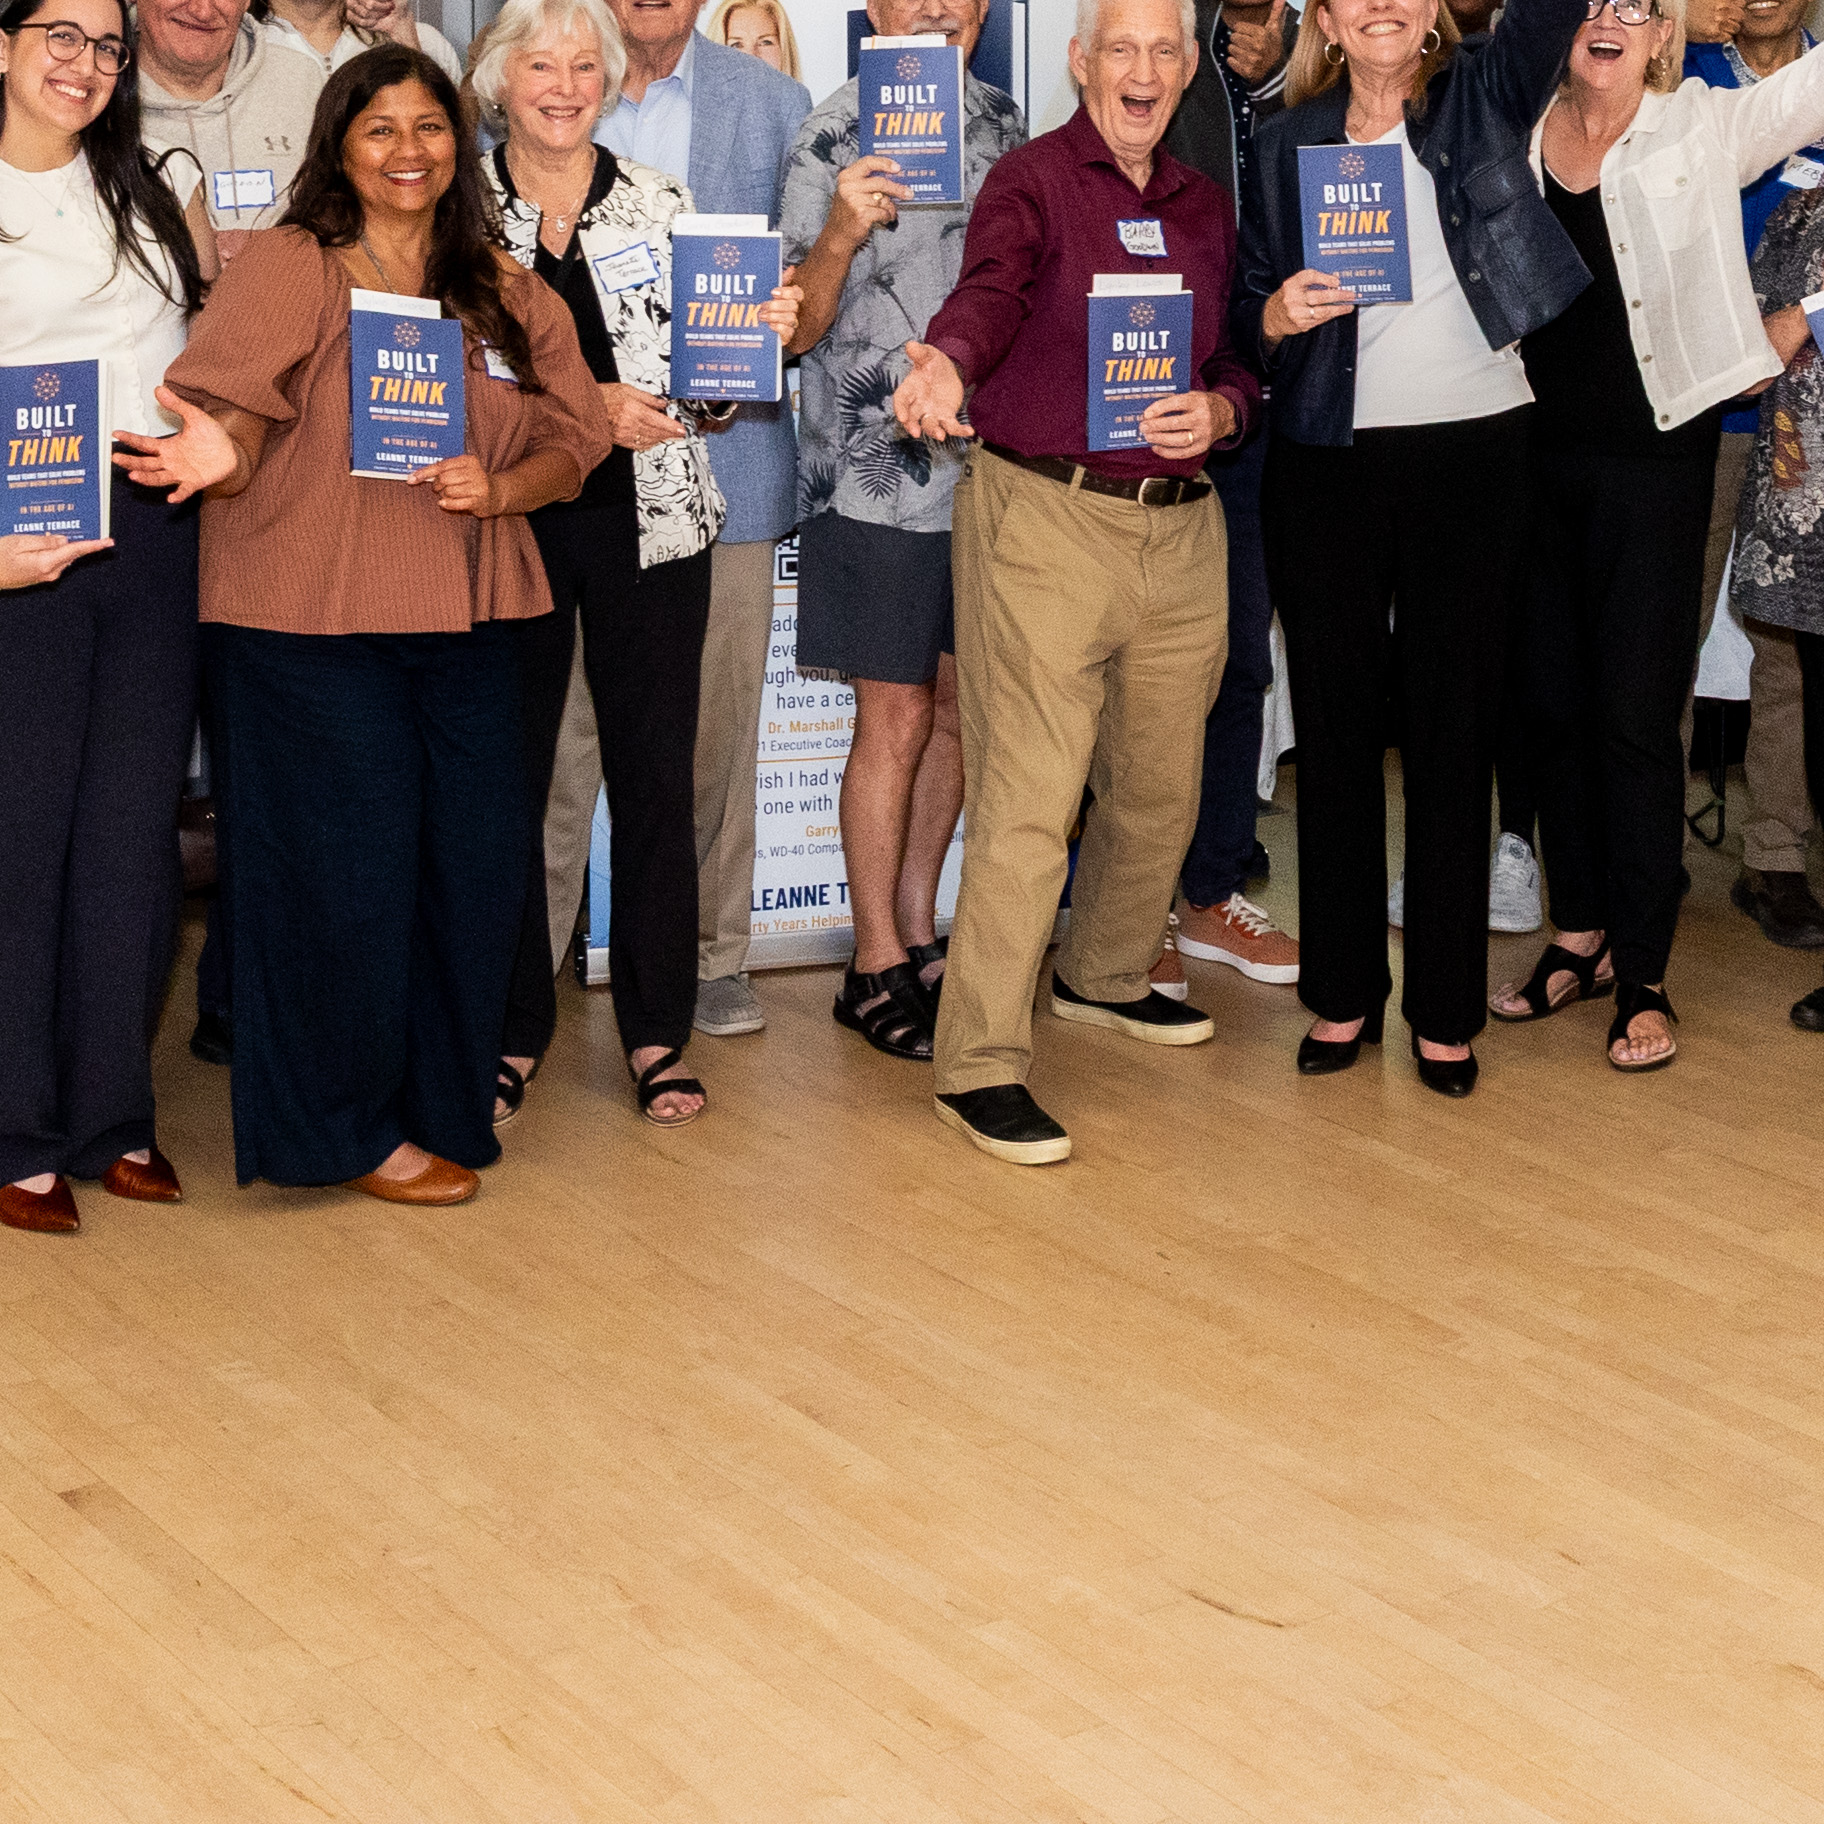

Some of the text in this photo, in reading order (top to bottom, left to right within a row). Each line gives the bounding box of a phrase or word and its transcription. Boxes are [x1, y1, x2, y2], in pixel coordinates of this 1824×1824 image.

[880, 84, 937, 104] BUILT
[873, 111, 947, 135] THINK
[1323, 182, 1383, 203] BUILT
[1317, 209, 1394, 235] THINK
[695, 273, 756, 294] BUILT
[686, 301, 765, 328] THINK
[1112, 330, 1169, 351] BUILT
[377, 349, 439, 373] BUILT
[1104, 356, 1176, 382] THINK
[369, 375, 449, 406] THINK
[690, 378, 756, 388] LEANNE TERRACE
[16, 404, 76, 430] BUILT
[8, 434, 85, 466] THINK
[376, 452, 406, 462] LEANNE
[14, 519, 81, 533] LEANNE TERRACE
[776, 692, 815, 709] have
[821, 694, 829, 707] a
[767, 721, 785, 734] Dr.
[789, 717, 844, 733] Marshall
[770, 738, 822, 752] Executive
[758, 771, 783, 789] ish
[799, 768, 829, 787] had
[763, 793, 833, 815] one with
[805, 824, 839, 838] Garry
[769, 844, 805, 857] WD-40
[751, 883, 830, 911] LEANNE
[774, 918, 807, 931] Years
